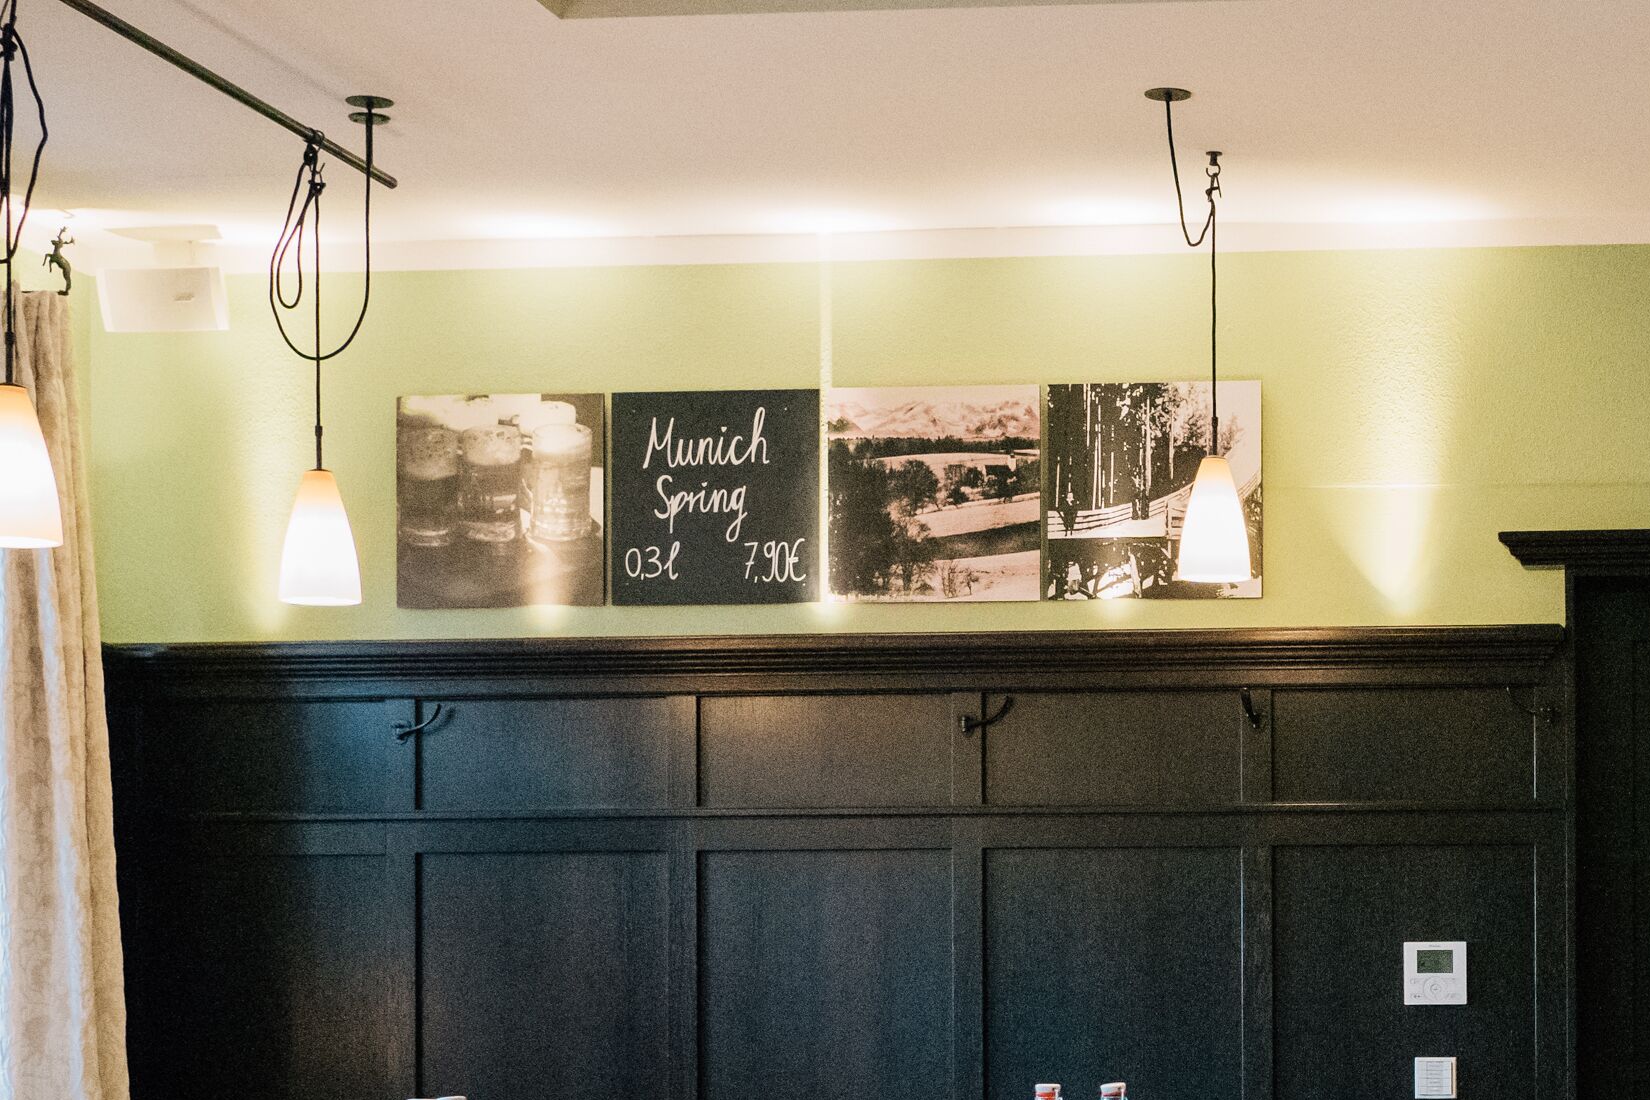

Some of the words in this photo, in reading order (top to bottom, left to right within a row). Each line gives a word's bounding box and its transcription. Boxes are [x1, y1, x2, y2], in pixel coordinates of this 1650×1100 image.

[643, 407, 770, 469] Munich
[654, 475, 748, 542] Spring
[625, 541, 681, 580] 0,3l
[744, 538, 806, 583] 7,90€
